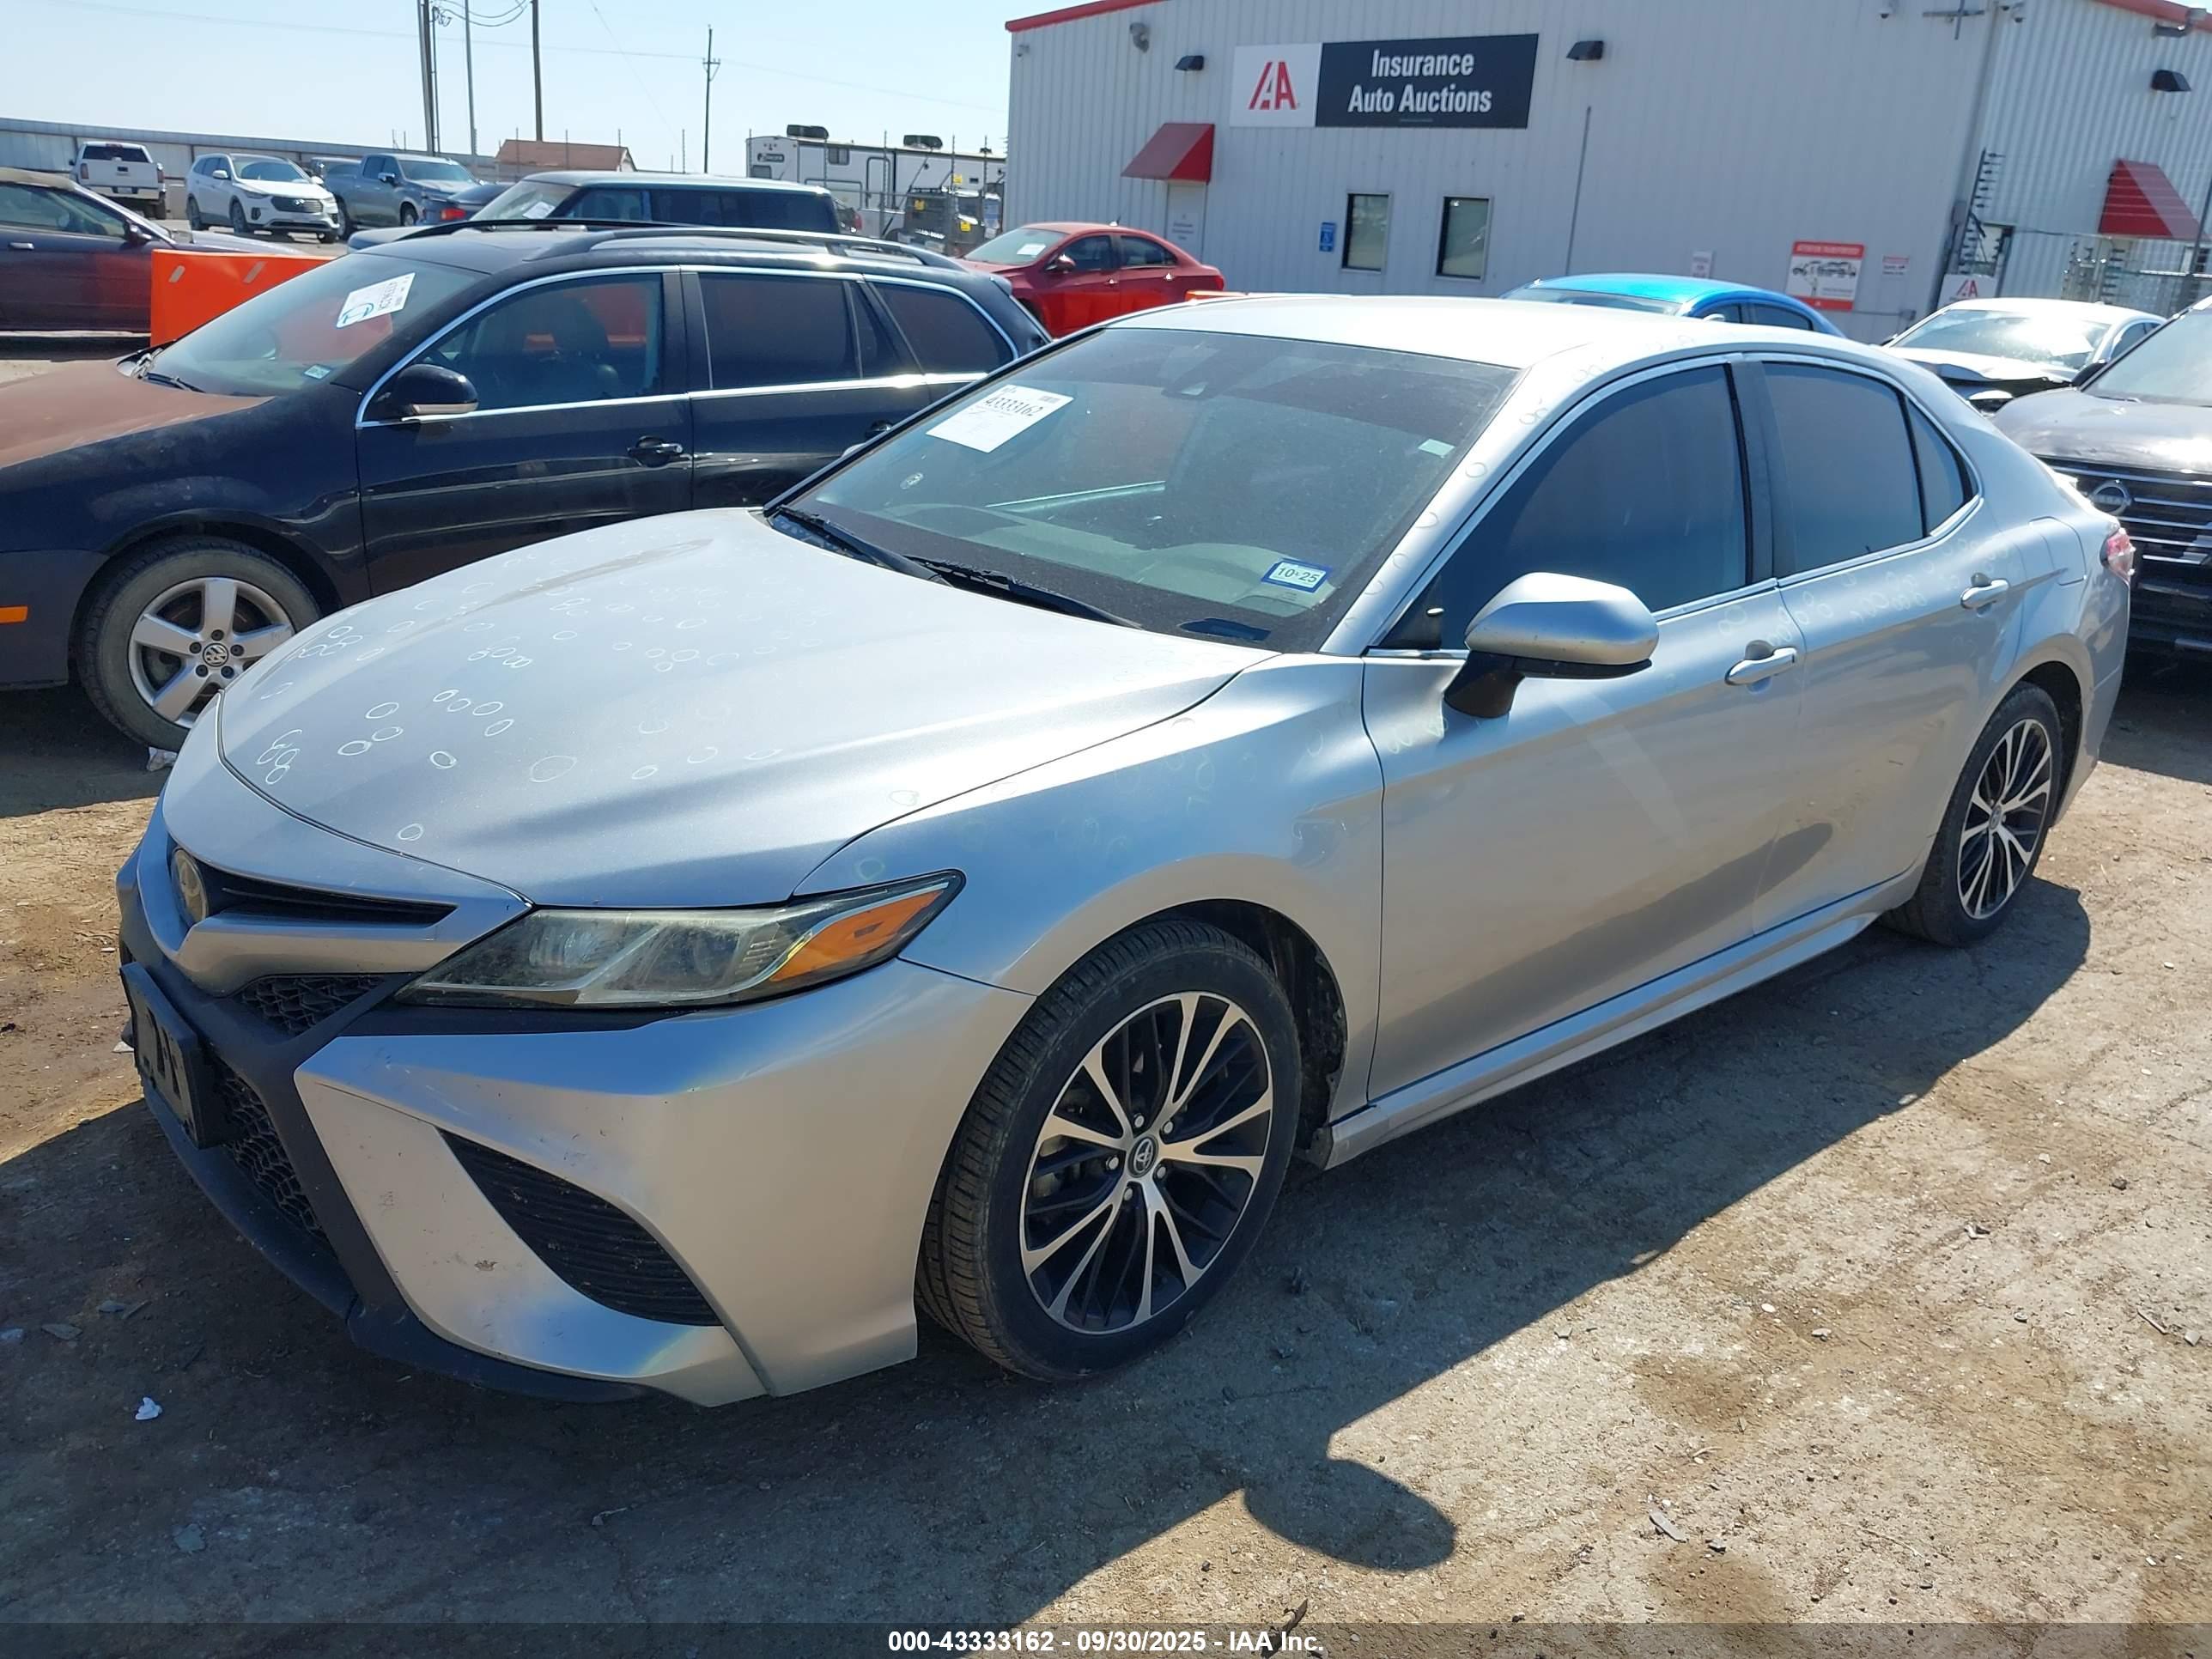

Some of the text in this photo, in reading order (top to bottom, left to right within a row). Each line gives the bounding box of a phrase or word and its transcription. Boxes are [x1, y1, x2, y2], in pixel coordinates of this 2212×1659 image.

[1371, 49, 1475, 78] Insurance
[1347, 83, 1493, 113] Auto Auctions
[985, 397, 1044, 417] 43333162
